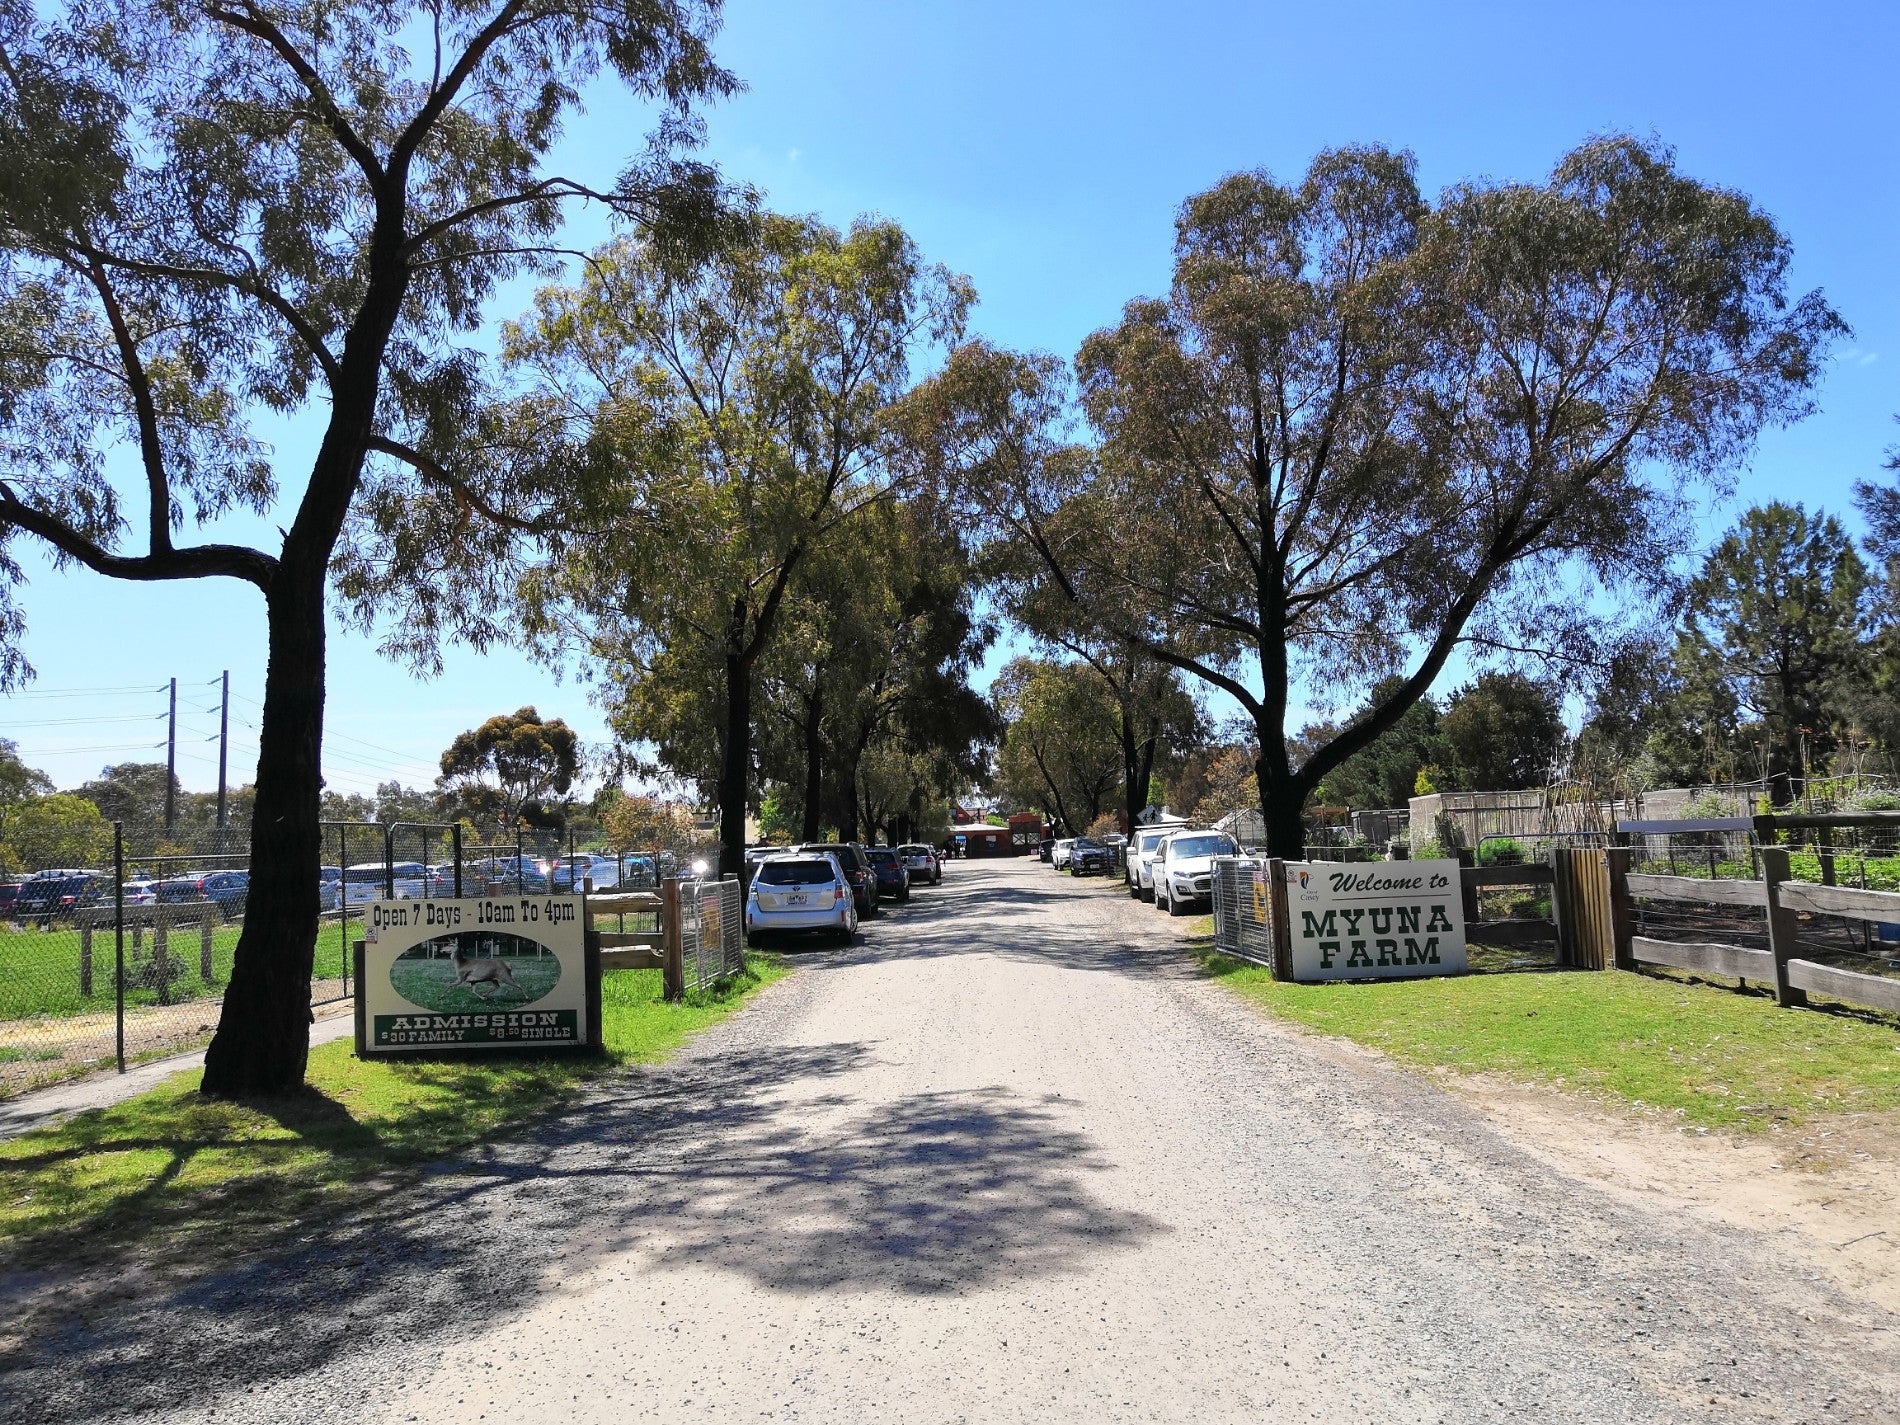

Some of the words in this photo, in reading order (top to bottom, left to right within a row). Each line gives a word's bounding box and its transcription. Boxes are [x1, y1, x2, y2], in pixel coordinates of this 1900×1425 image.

[1328, 872, 1424, 893] Welcome
[1428, 872, 1450, 890] to
[374, 905, 407, 930] Open
[413, 903, 421, 925] 7
[426, 903, 461, 929] Days
[477, 901, 516, 924] 10am
[520, 900, 539, 922] To
[544, 900, 575, 925] 4pm
[1301, 905, 1454, 939] MYUNA
[1319, 937, 1441, 969] FARM
[391, 1013, 559, 1030] ADMISSION
[381, 1031, 406, 1043] $30
[408, 1030, 466, 1042] FAMILY
[521, 1026, 572, 1039] SINGLE
